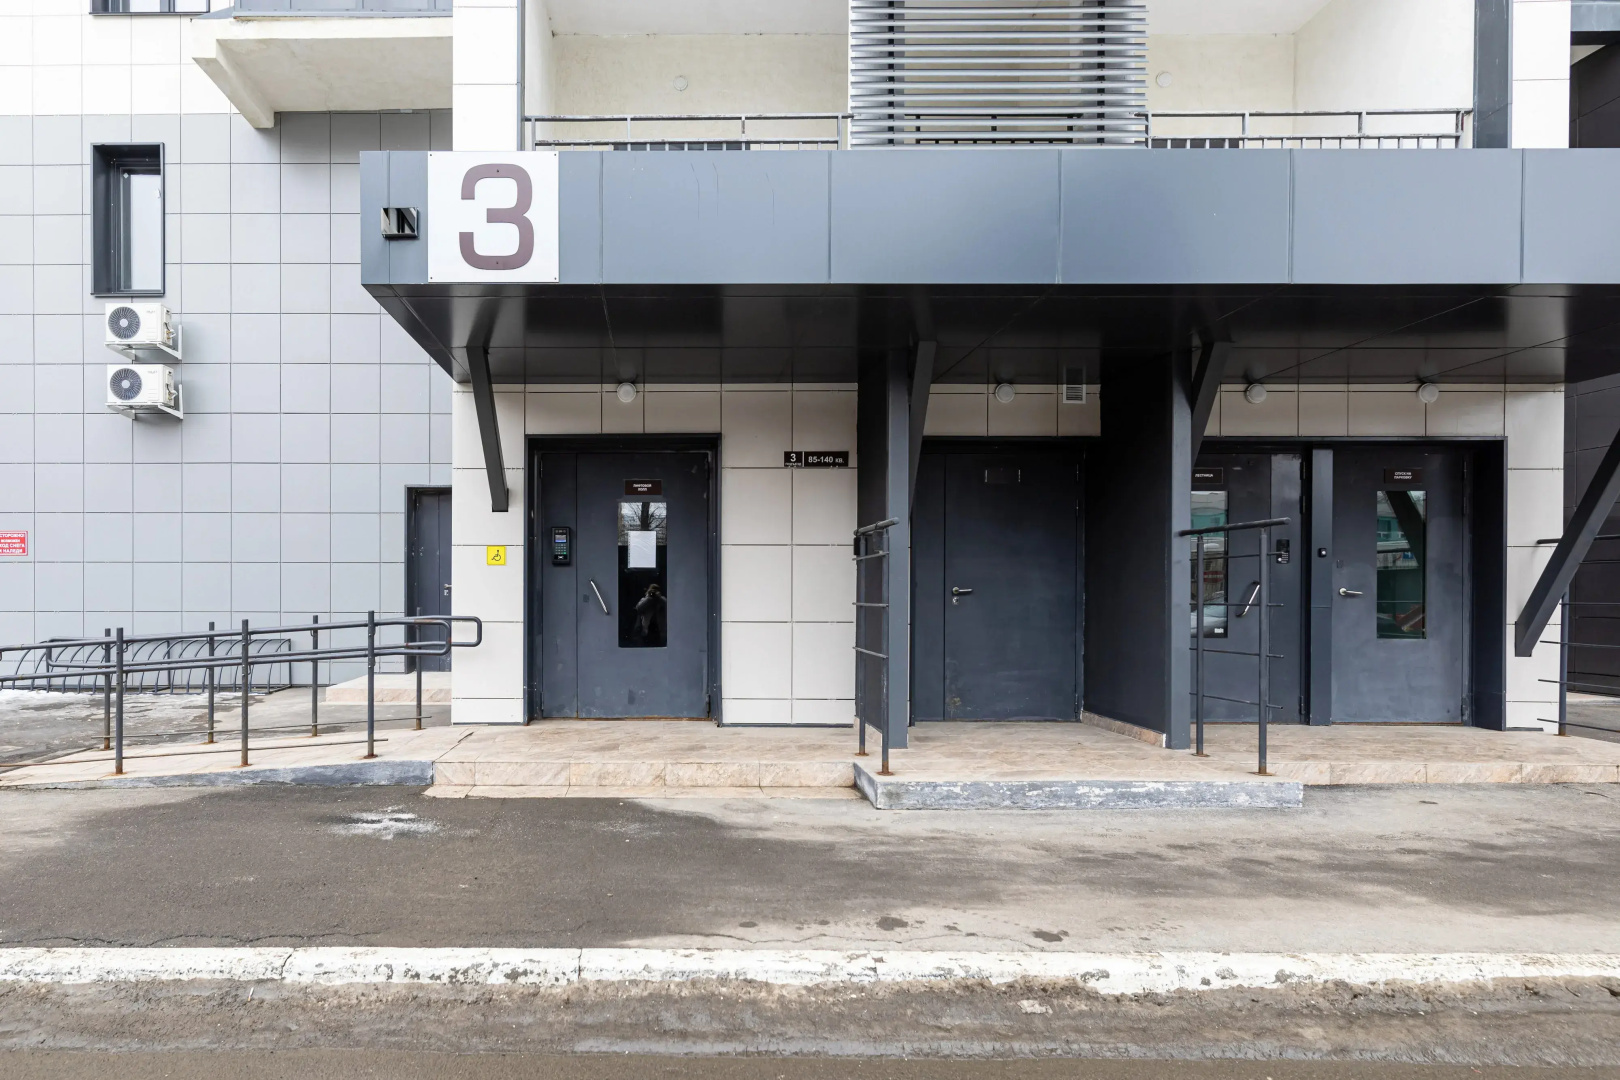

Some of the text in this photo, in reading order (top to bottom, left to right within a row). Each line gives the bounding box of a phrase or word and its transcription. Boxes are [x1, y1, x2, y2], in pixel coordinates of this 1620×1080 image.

[459, 163, 535, 271] 3
[790, 453, 797, 462] 3
[808, 455, 834, 463] 85-140
